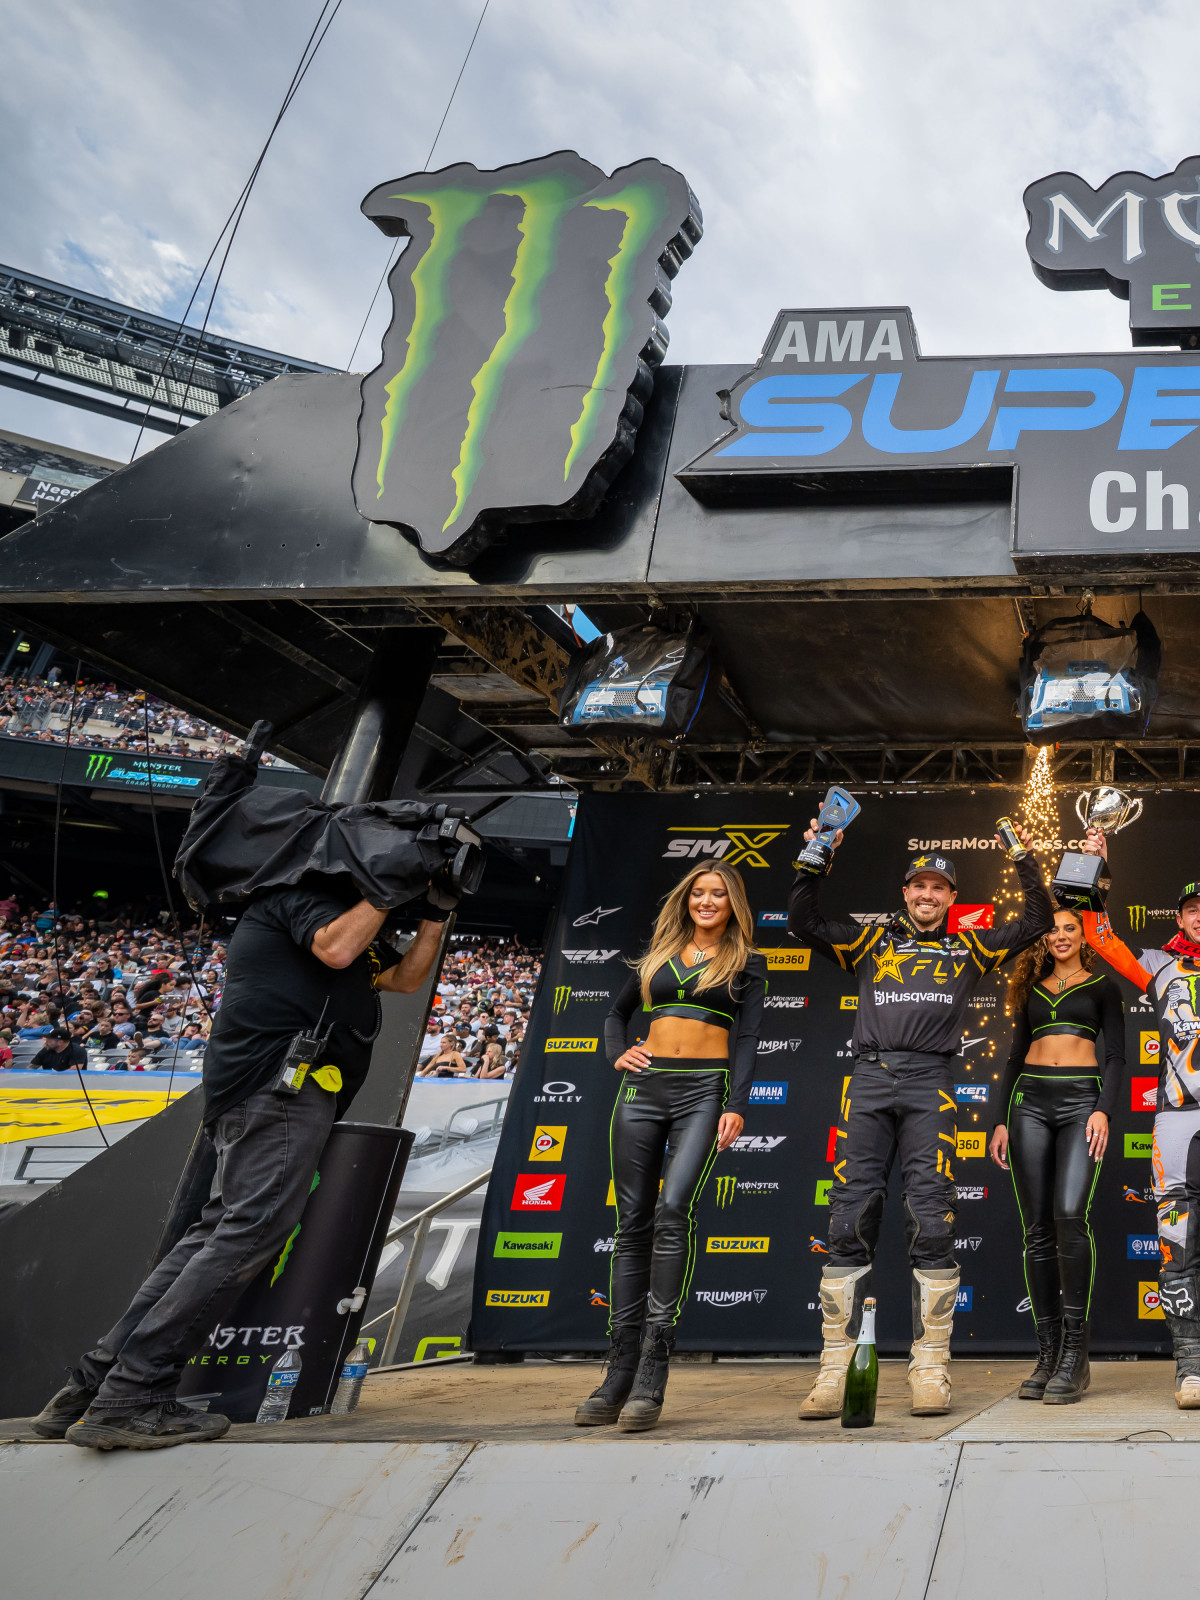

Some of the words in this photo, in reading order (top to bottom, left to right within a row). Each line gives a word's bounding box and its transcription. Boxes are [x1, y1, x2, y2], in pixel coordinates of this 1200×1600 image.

[771, 320, 904, 363] AMA
[125, 780, 178, 789] CHAMPONSHIP
[662, 832, 780, 868] SMX
[911, 960, 966, 978] FLY
[571, 989, 610, 998] MONSTER
[885, 991, 953, 1004] Husqvarna
[547, 1041, 594, 1050] SUZUKI
[534, 1095, 582, 1103] OAKLEY
[737, 1181, 779, 1190] MONSTER
[502, 1240, 553, 1250] Kawasaki
[710, 1240, 764, 1250] SUZUKI
[490, 1294, 544, 1303] SUZUKI
[696, 1291, 752, 1305] TRIUMPH
